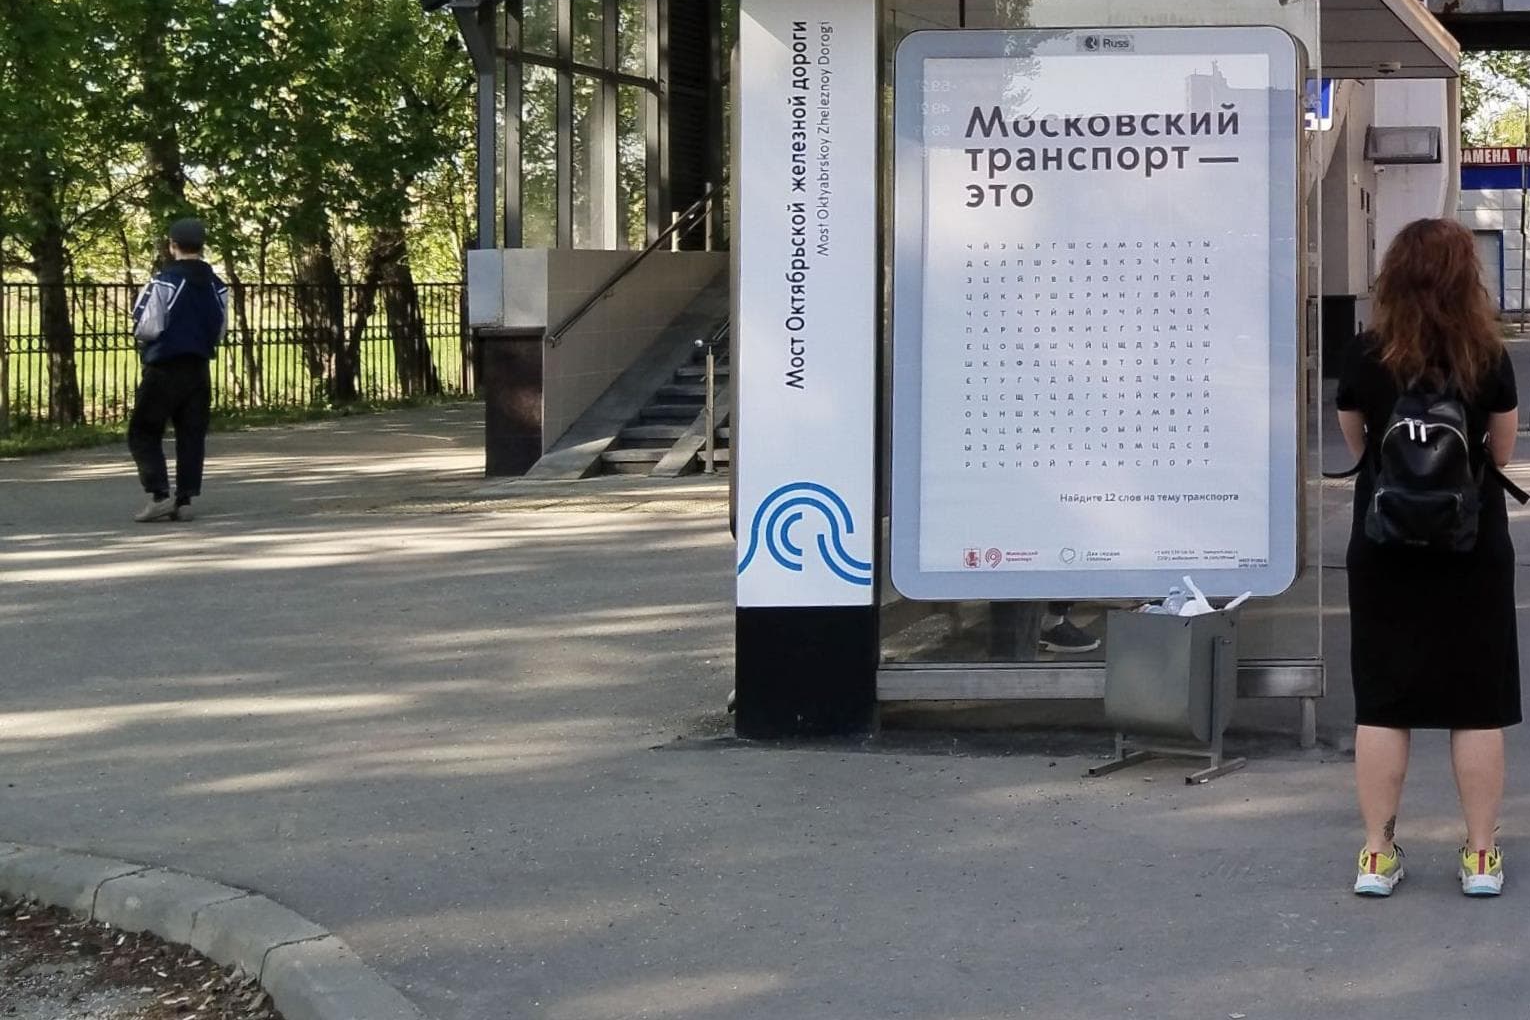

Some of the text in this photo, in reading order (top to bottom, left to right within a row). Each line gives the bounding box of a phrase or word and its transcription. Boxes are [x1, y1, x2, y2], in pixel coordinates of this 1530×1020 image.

[1102, 38, 1130, 50] Russ
[964, 102, 1240, 139] Московский
[816, 21, 834, 257] Most Oktyabrskoy Zheleznoy Dorogi
[785, 21, 812, 389] Мост Октябрьской железной дороги
[965, 182, 1034, 209] это
[1059, 492, 1239, 504] Найдите 12 слов на тему транспорта
